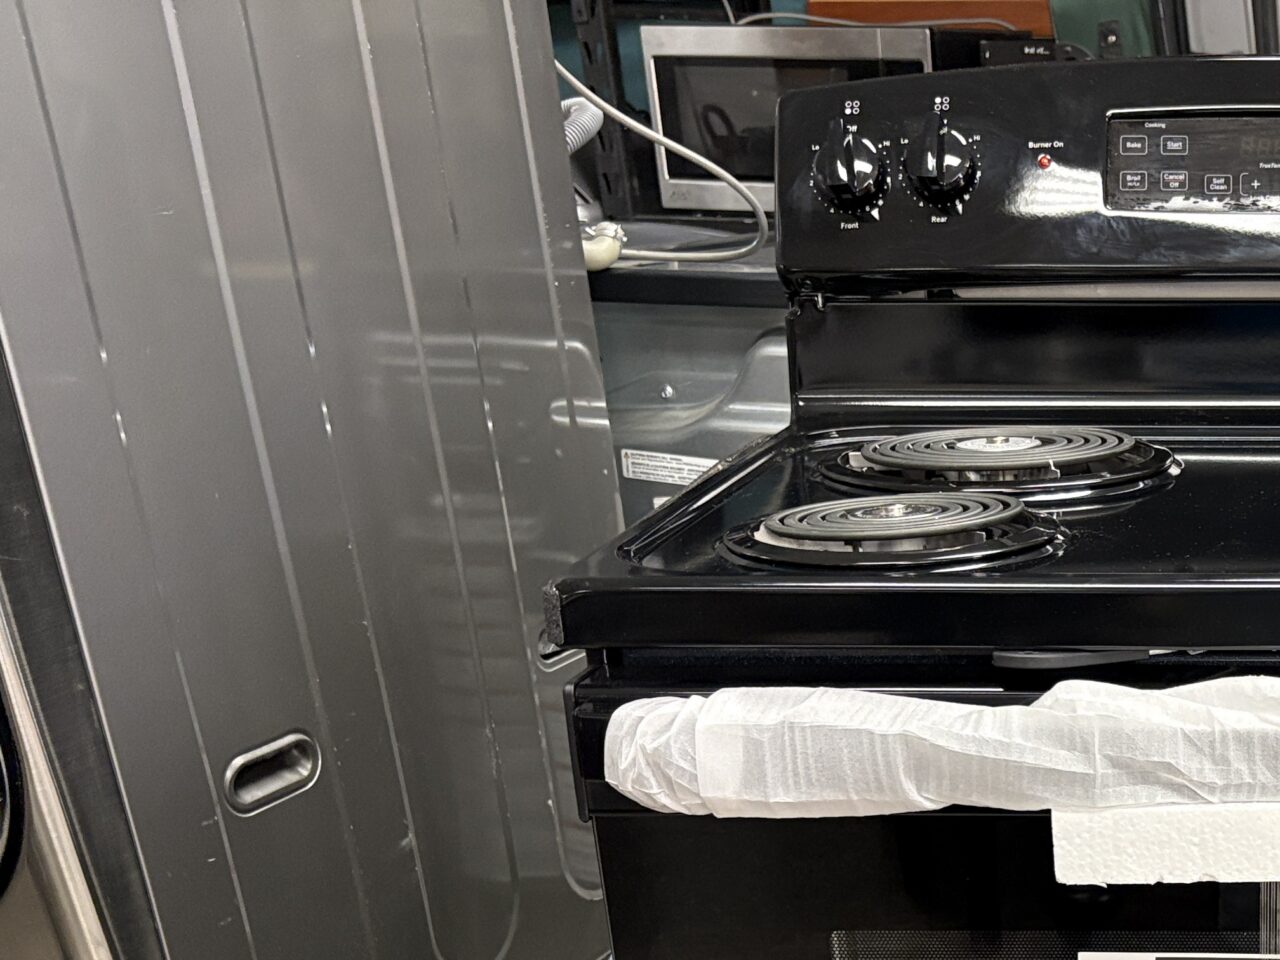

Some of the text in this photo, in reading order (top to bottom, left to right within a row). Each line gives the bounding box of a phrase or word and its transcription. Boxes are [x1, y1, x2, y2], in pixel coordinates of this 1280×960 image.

[1028, 140, 1064, 149] Burner On
[1126, 141, 1142, 149] Bake
[1166, 140, 1183, 149] Start
[931, 215, 948, 223] Rear
[840, 222, 859, 230] Front
